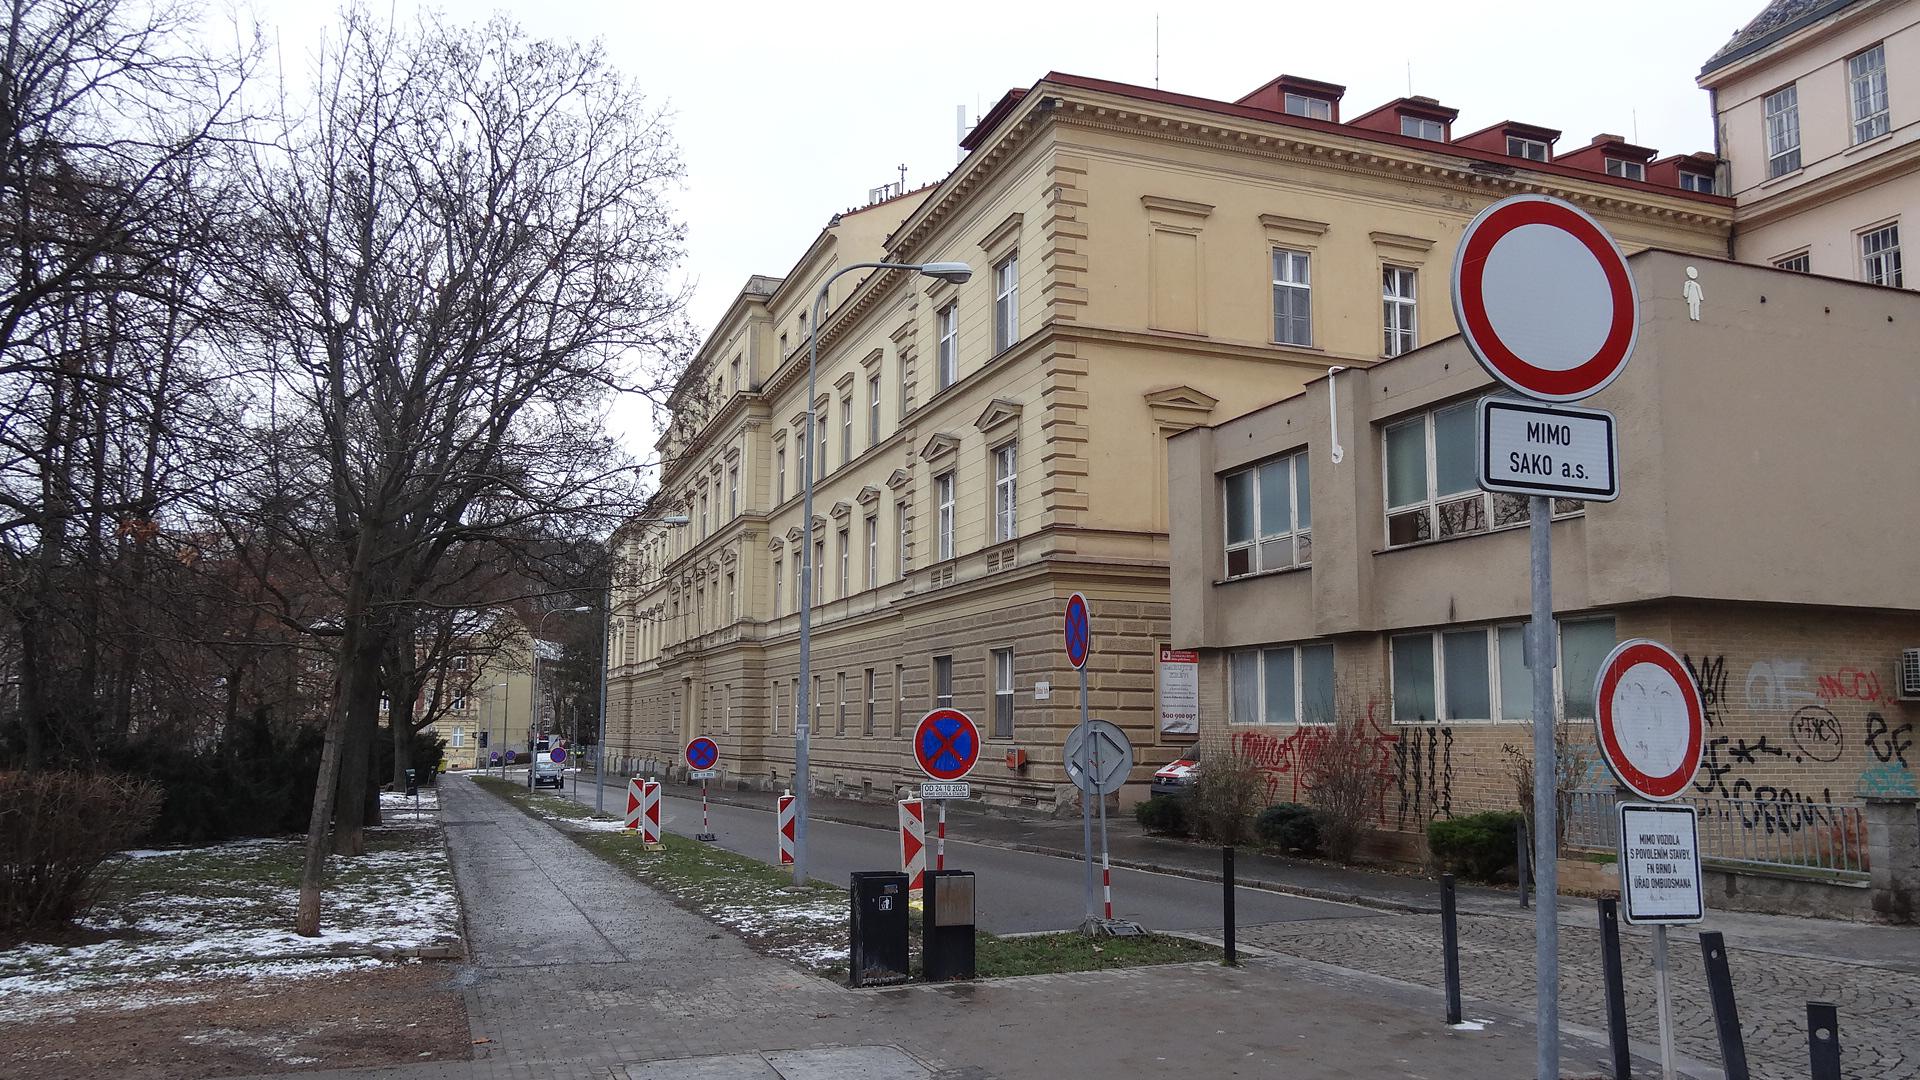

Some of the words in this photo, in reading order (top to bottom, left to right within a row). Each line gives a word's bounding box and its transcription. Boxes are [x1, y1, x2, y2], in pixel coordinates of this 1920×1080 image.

[1527, 421, 1571, 446] MIMO
[1510, 451, 1552, 475] SAKO
[1562, 462, 1589, 480] a.s.
[1639, 834, 1655, 845] MIMO
[1656, 834, 1680, 845] VOZIDLA
[1630, 848, 1635, 859] S
[1636, 847, 1668, 860] POVOLENÍM
[1646, 863, 1655, 874] FN
[1656, 863, 1672, 874] BRNO
[1672, 863, 1677, 874] A
[1634, 875, 1650, 889] ÚŘAD
[1650, 877, 1692, 889] OMBUDSMANA
